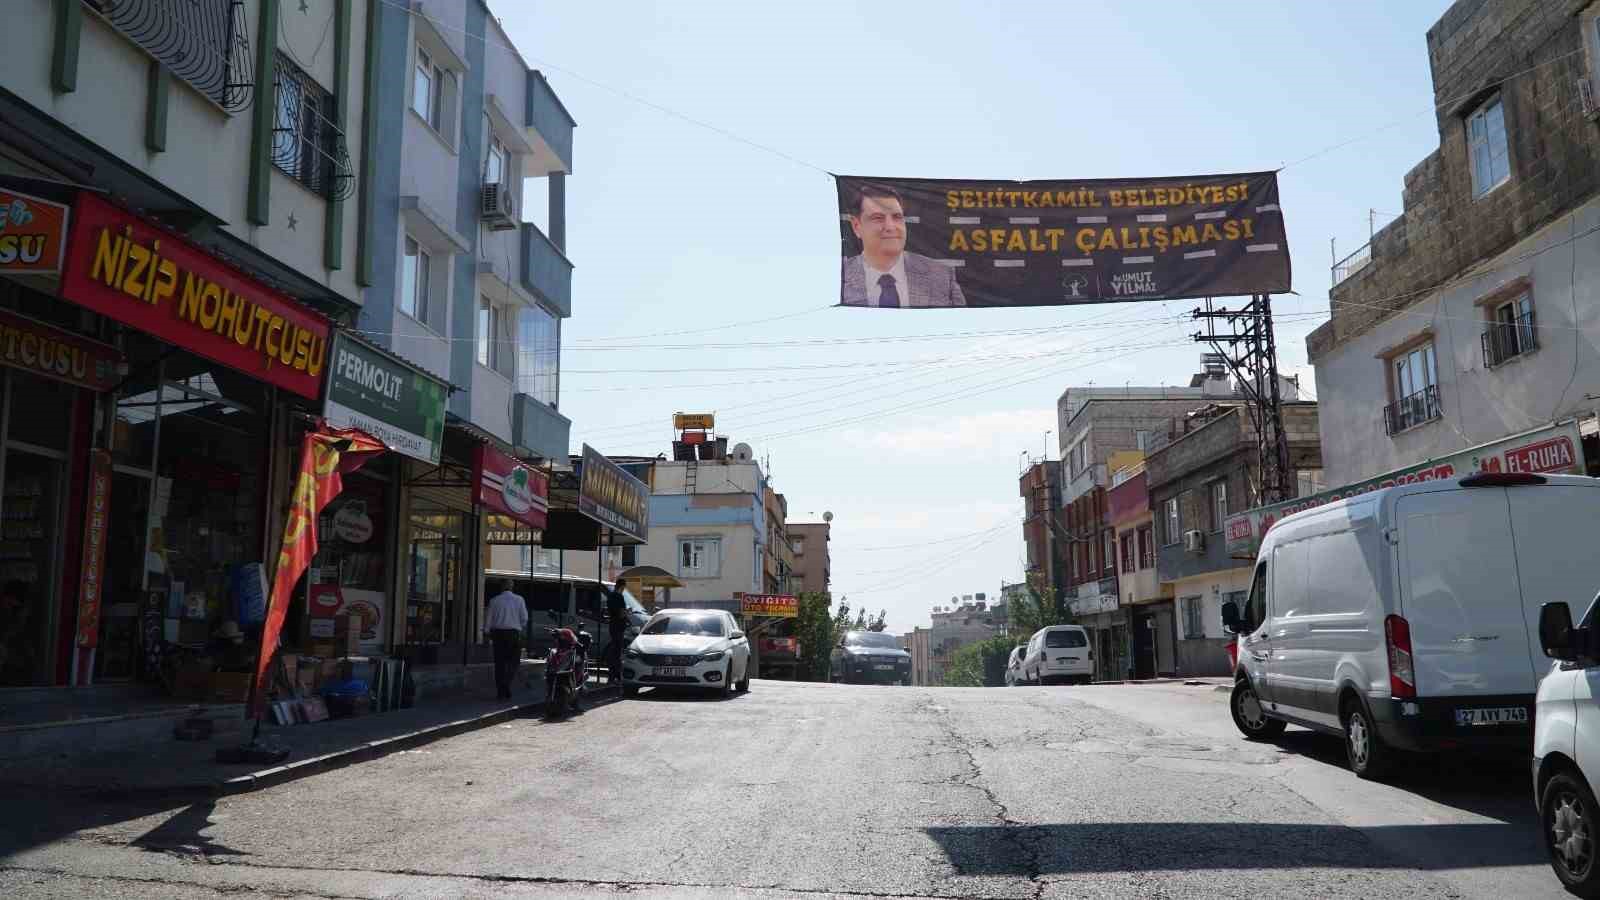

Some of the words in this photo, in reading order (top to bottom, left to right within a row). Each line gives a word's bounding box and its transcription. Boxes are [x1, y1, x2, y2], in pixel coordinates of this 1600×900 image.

[946, 185, 1101, 209] ŞEHİTKAMİL
[1109, 183, 1249, 208] BELEDİYESİ
[949, 228, 1065, 252] ASFALT
[1075, 217, 1254, 256] ÇALIŞMASI
[92, 224, 177, 305] NİZİP
[179, 270, 325, 377] NOHUTÇUSU
[1507, 442, 1572, 473] EL-RUHA
